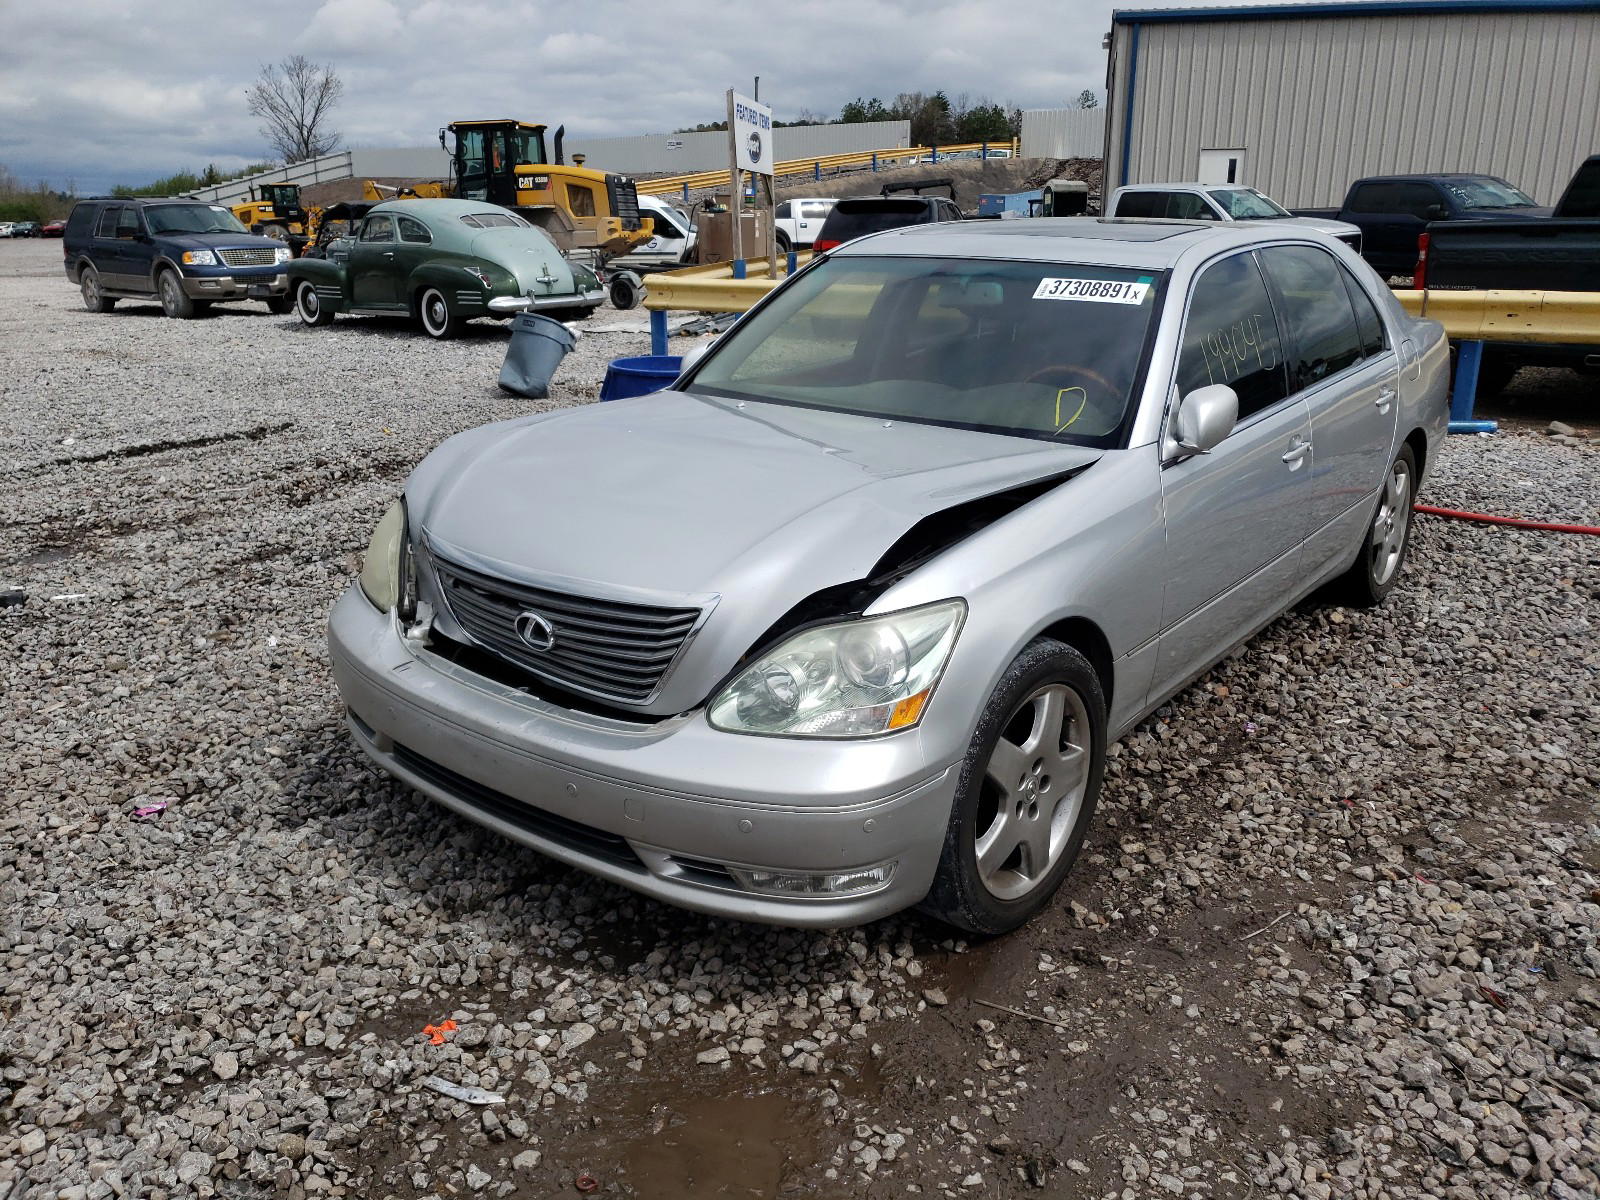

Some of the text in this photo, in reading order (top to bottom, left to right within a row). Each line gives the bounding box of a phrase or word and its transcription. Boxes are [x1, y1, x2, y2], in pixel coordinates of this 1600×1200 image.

[736, 103, 770, 131] FEATURED ITEMS
[518, 176, 534, 189] CAT
[1053, 386, 1087, 437] D
